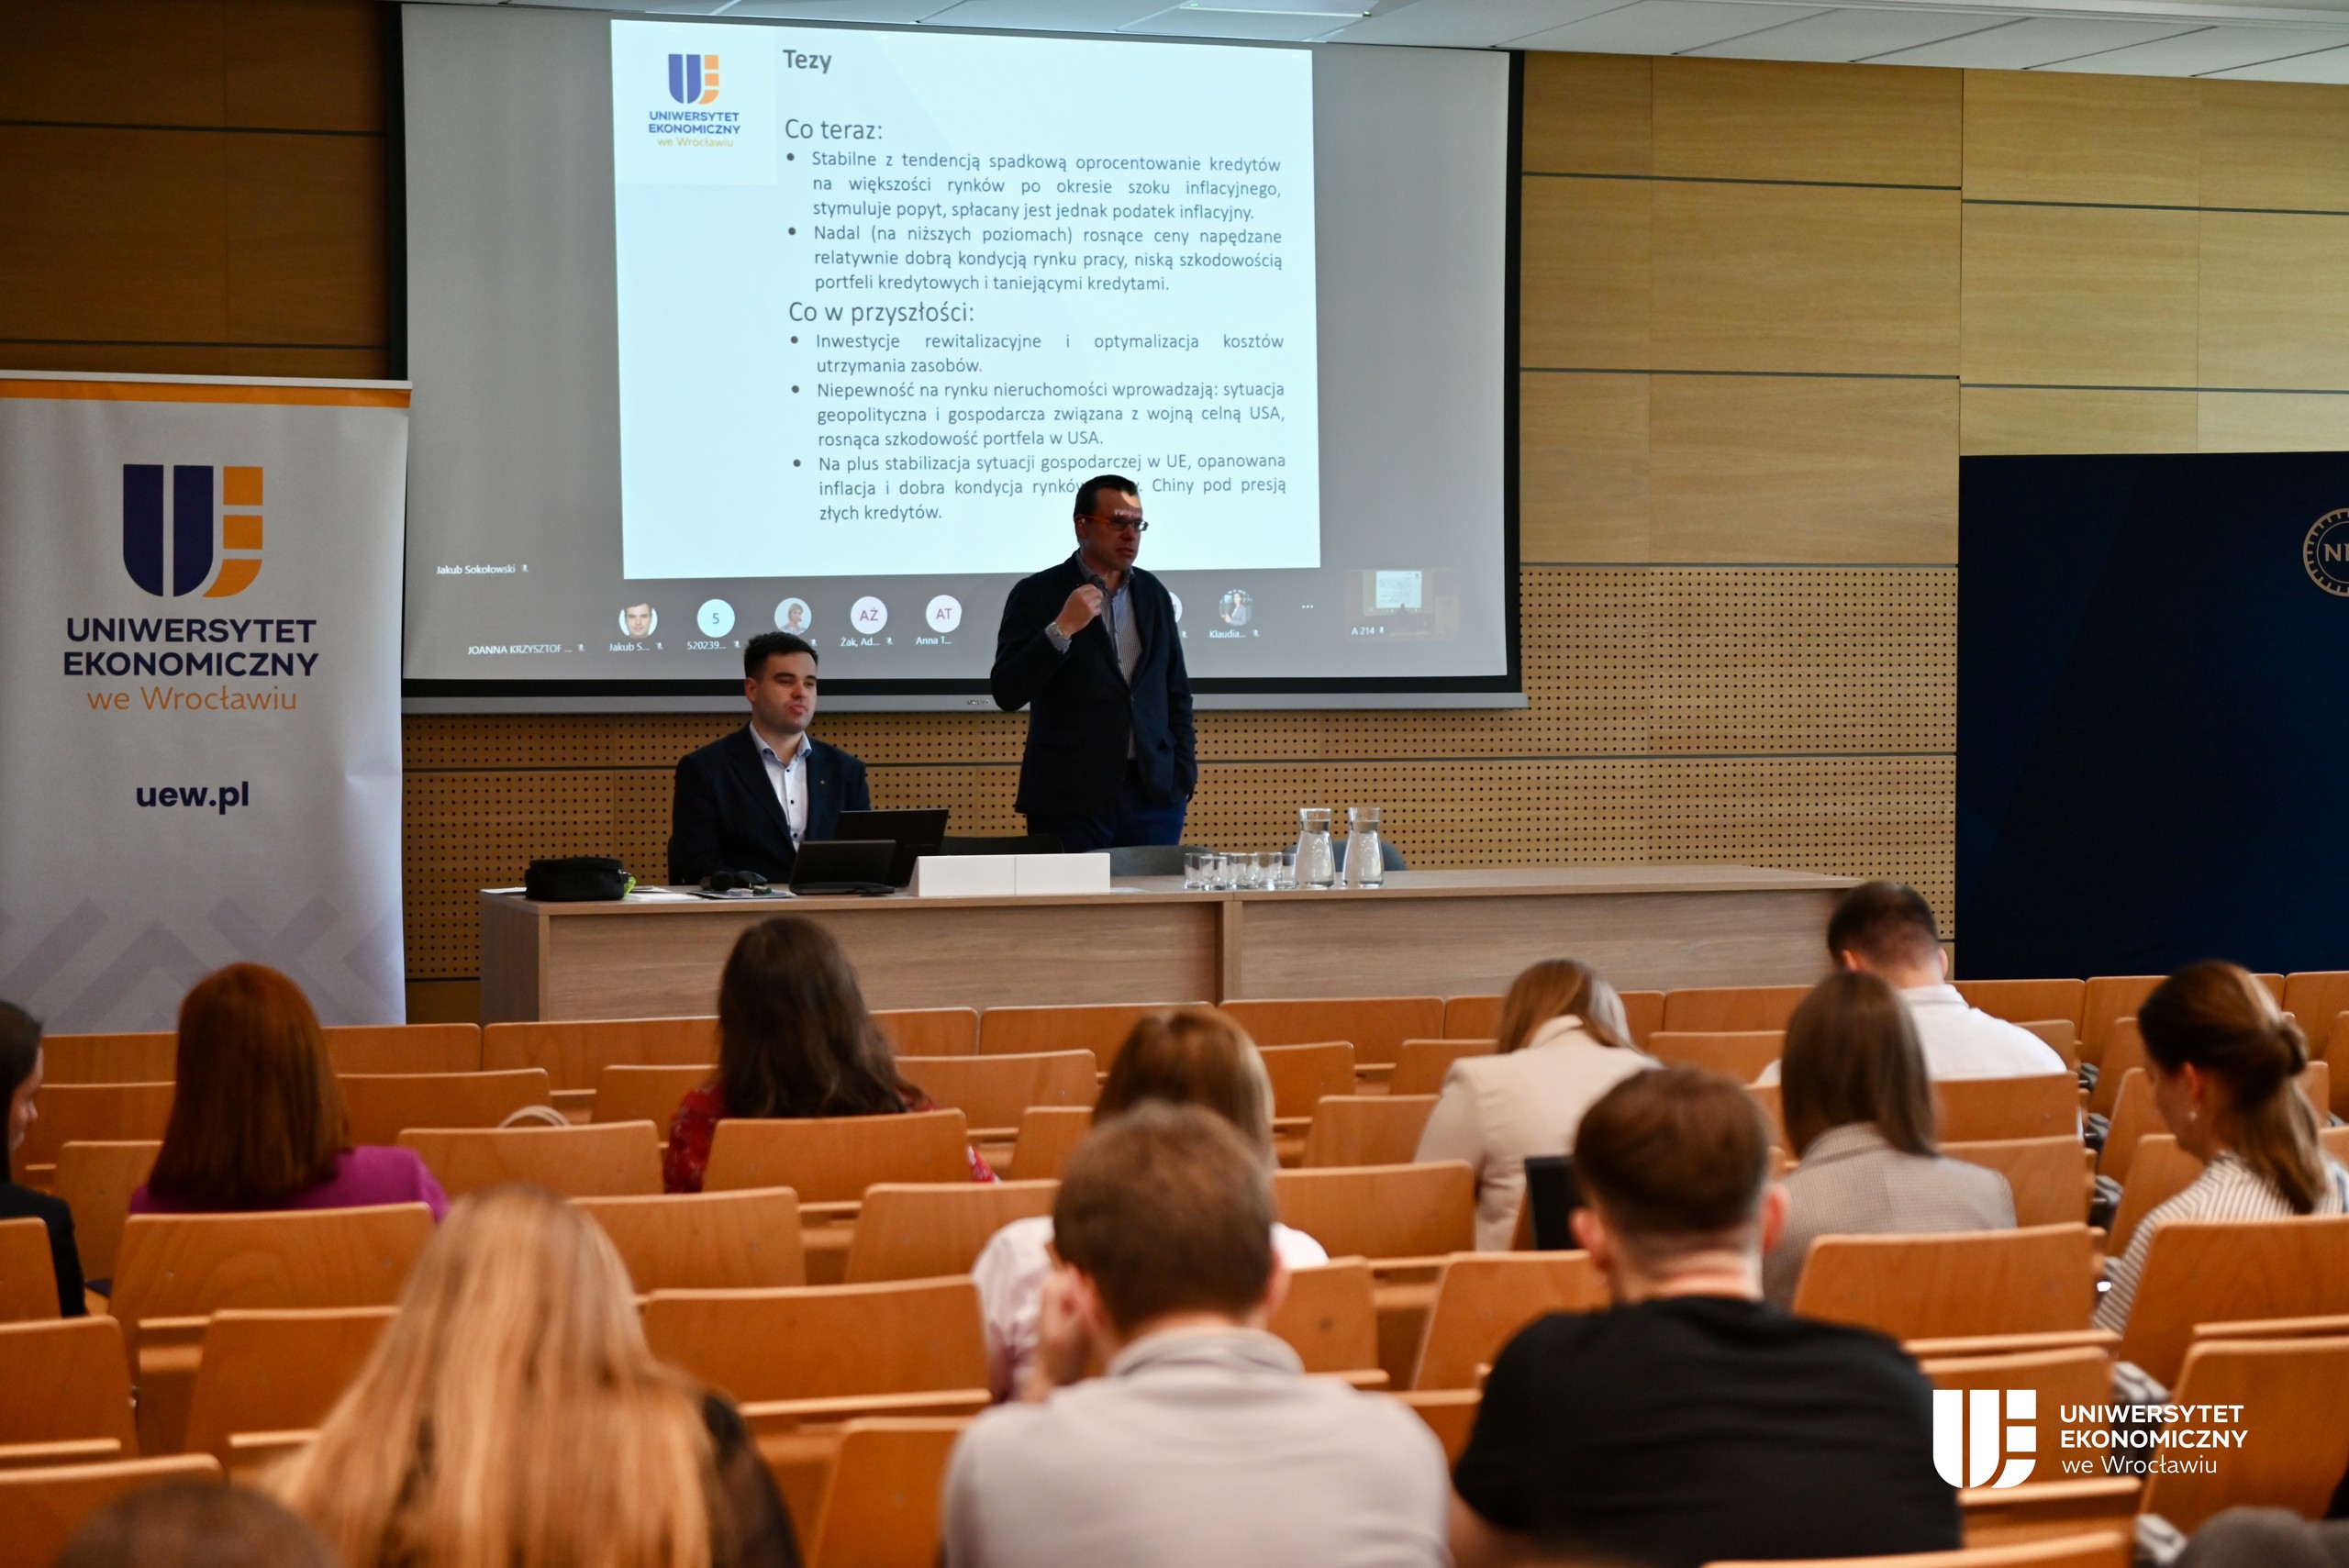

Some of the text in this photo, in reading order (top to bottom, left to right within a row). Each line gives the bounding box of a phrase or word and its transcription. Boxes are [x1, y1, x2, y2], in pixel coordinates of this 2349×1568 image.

[782, 49, 833, 74] Tezy
[650, 111, 740, 122] UNIWERSYTET
[649, 123, 741, 135] EKONOMICZNY
[785, 117, 883, 140] Co teraz:
[811, 150, 1282, 175] Stabilne z tendencją spadkową oprocentowanie kredytów
[813, 175, 1281, 199] na większości rynków po okresie szoku inflacyjnego,
[813, 200, 1254, 223] stymuluje popyt, spłacany jest jednak podatek inflacyjny.
[814, 224, 1283, 247] Nadal (na niższych poziomach) rosnące ceny napędzane
[814, 249, 1283, 272] relatywnie dobrą kondycją rynku pracy, niską szkodowością
[815, 273, 874, 293] portfeli
[878, 273, 980, 294] kredytowych
[993, 274, 1083, 294] taniejącymi
[1087, 275, 1170, 295] kredytami.
[788, 300, 974, 327] Co w przyszłości:
[816, 333, 901, 352] Inwestycje
[925, 332, 1041, 352] rewitalizacyjne
[1094, 333, 1199, 352] optymalizacja
[1223, 333, 1285, 349] kosztów
[817, 356, 983, 376] utrzymania zasobów.
[818, 381, 1285, 401] Niepewność na rynku nieruchomości wprowadzają: sytuacja
[817, 406, 927, 426] geopolityczna
[948, 406, 1046, 426] gospodarcza
[1053, 406, 1123, 425] związana
[1131, 409, 1139, 421] z
[1146, 406, 1194, 424] wojną
[1201, 405, 1241, 424] celną
[1250, 406, 1285, 423] USA,
[818, 429, 1104, 450] rosnąca szkodowość portfela w USA.
[818, 453, 1286, 474] Na plus stabilizacja sytuacji gospodarczej w UE, opanowana
[818, 480, 876, 499] inflacja
[898, 479, 945, 495] dobra
[954, 478, 1023, 497] kondycja
[1152, 477, 1195, 495] Chiny
[1203, 476, 1231, 495] pod
[1241, 476, 1286, 495] presją
[819, 503, 942, 524] złych kredytów.
[436, 563, 516, 575] Jakub Sokołowski
[712, 612, 720, 625] 5
[935, 607, 952, 621] AT
[67, 617, 317, 643] UNIWERSYTET
[1352, 627, 1375, 636] A 214
[467, 645, 508, 655] JOANNA
[510, 644, 562, 654] KRZYSZTOF
[609, 642, 635, 651] Jakub
[916, 636, 939, 646] Anna
[63, 651, 319, 676] EKONOMICZNY
[87, 685, 297, 710] we Wrocławiu
[136, 781, 250, 816] uew.pl
